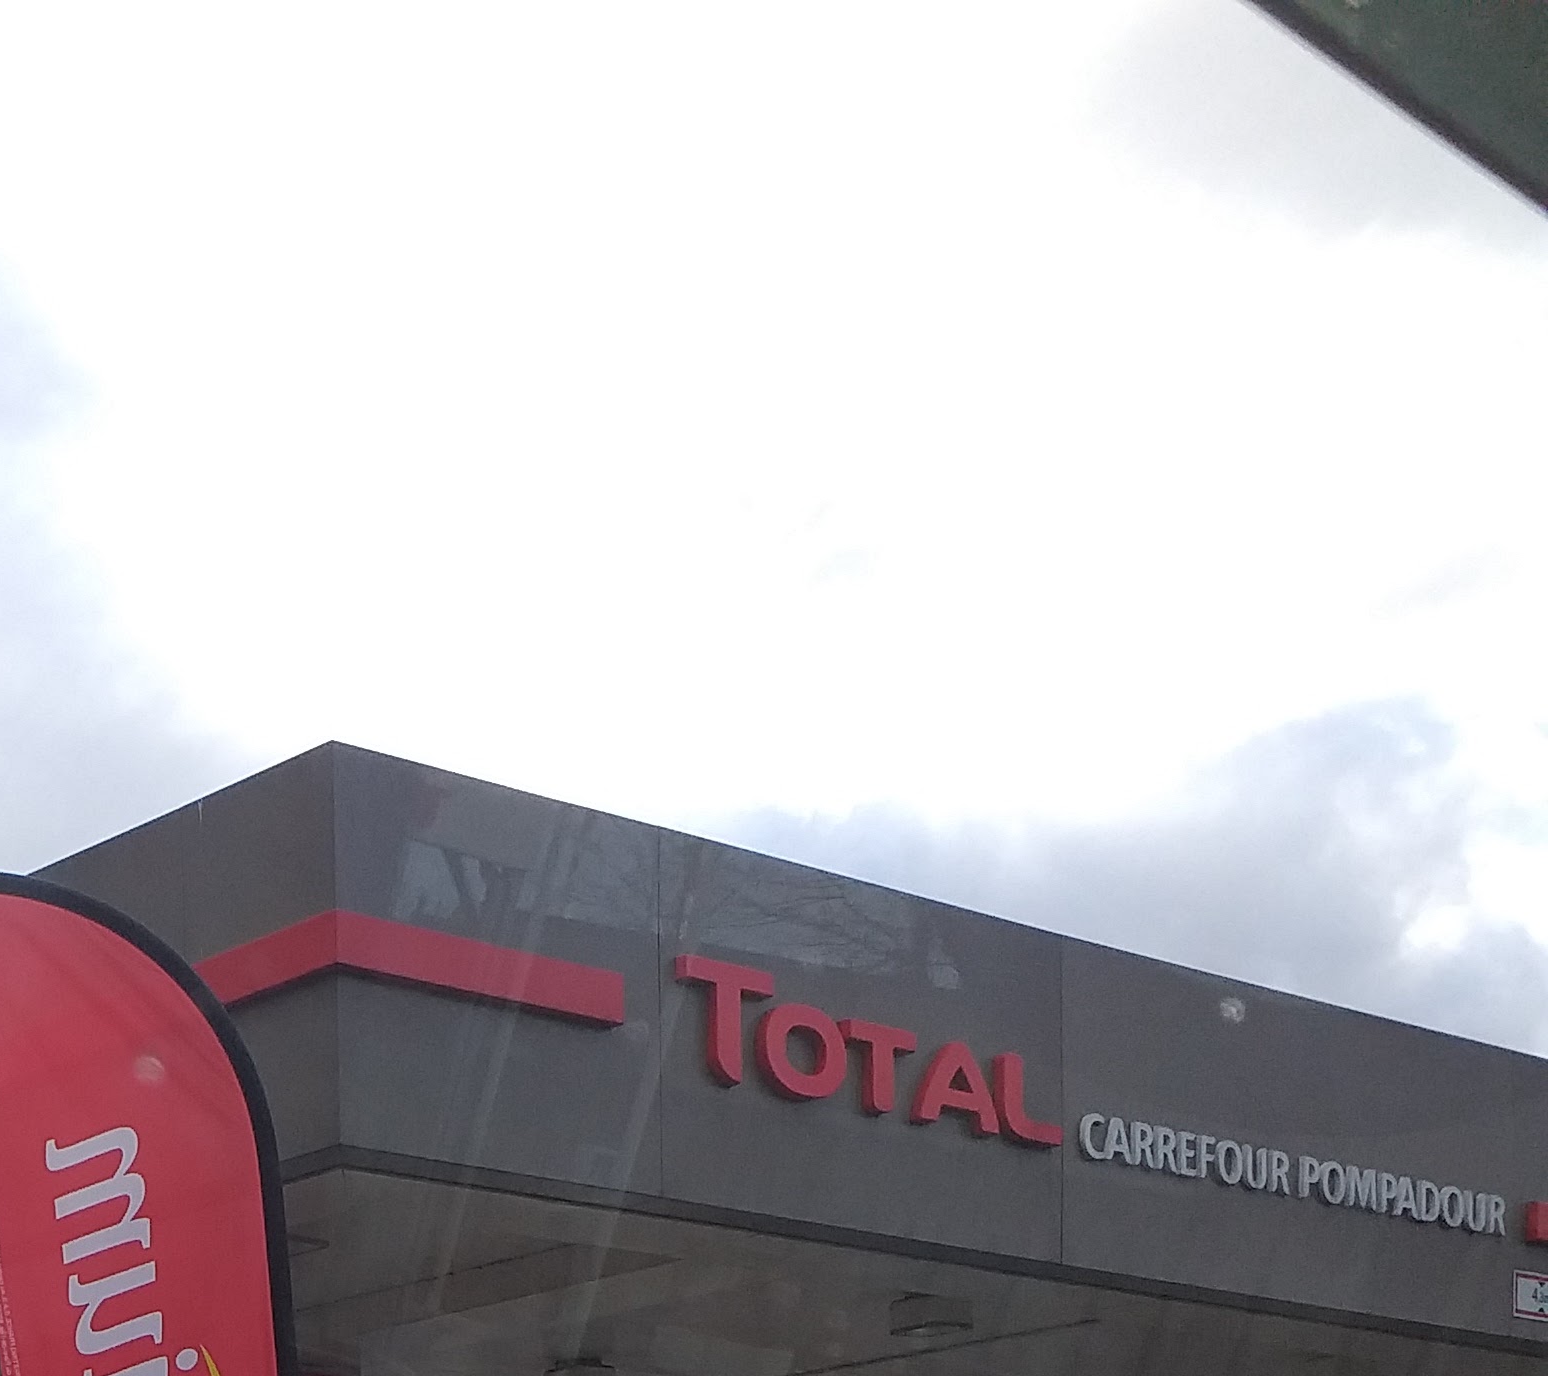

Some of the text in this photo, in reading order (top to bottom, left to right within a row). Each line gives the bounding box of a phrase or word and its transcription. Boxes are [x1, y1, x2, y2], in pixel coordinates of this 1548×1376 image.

[675, 954, 1063, 1146] TOTAL
[1078, 1112, 1506, 1236] CARREFOUR POMPADOUR
